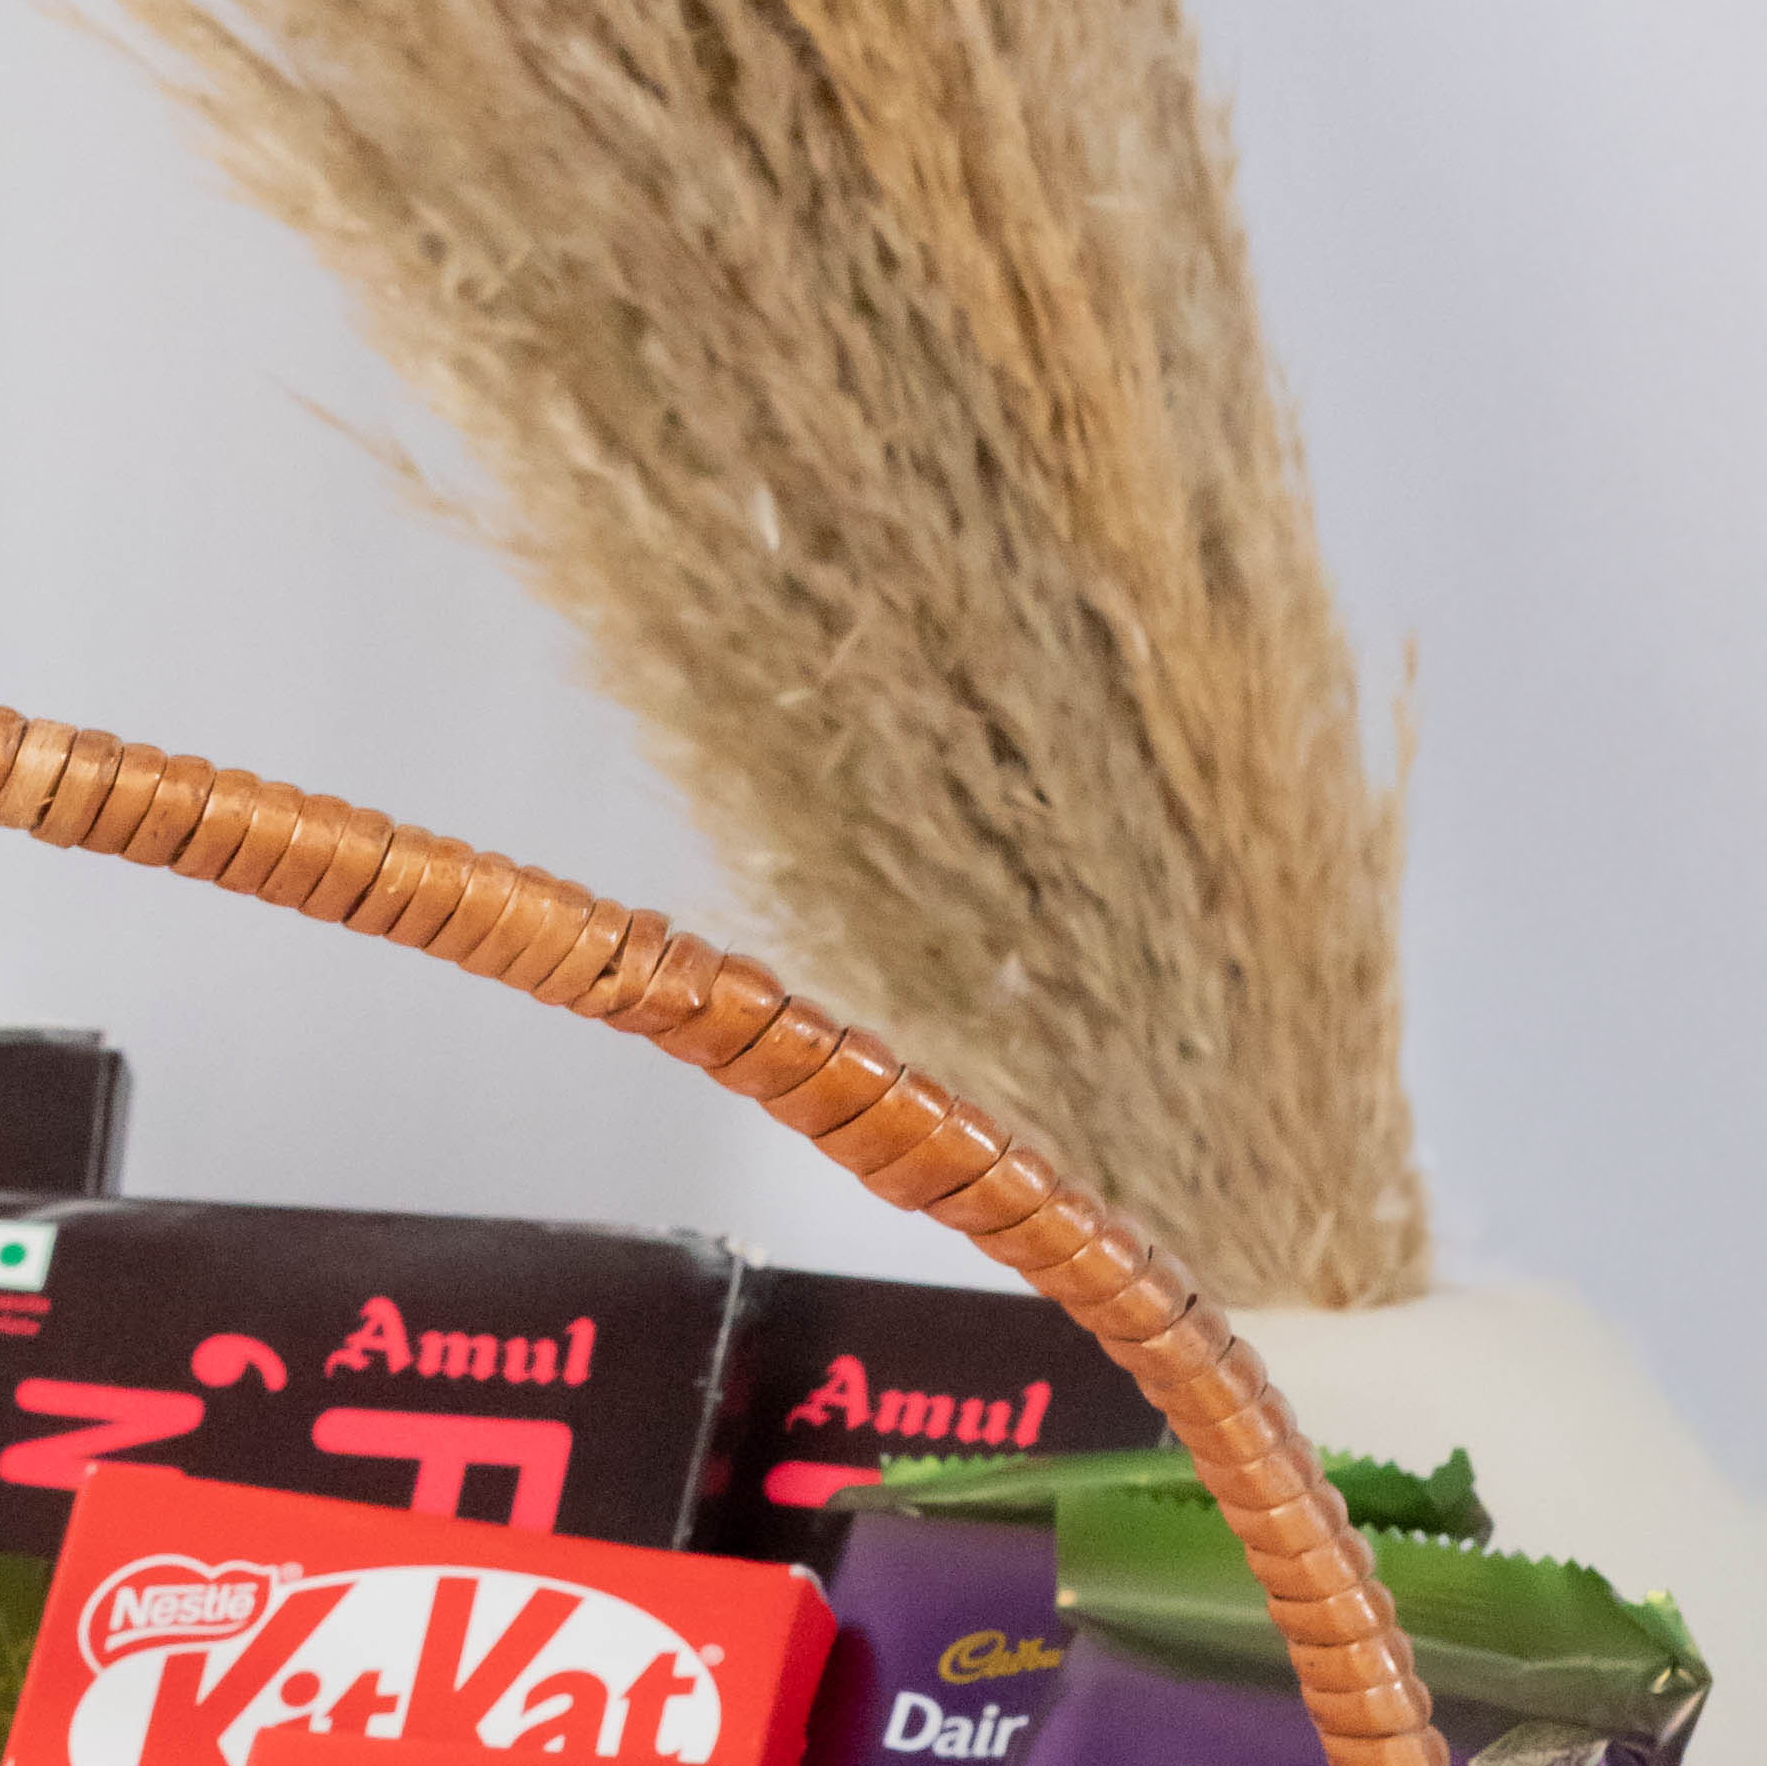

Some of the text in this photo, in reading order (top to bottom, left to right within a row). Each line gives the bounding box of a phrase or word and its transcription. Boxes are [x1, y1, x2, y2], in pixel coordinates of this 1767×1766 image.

[324, 1297, 596, 1387] Amul
[786, 1355, 1051, 1448] Amul
[883, 1691, 1029, 1759] Dair
